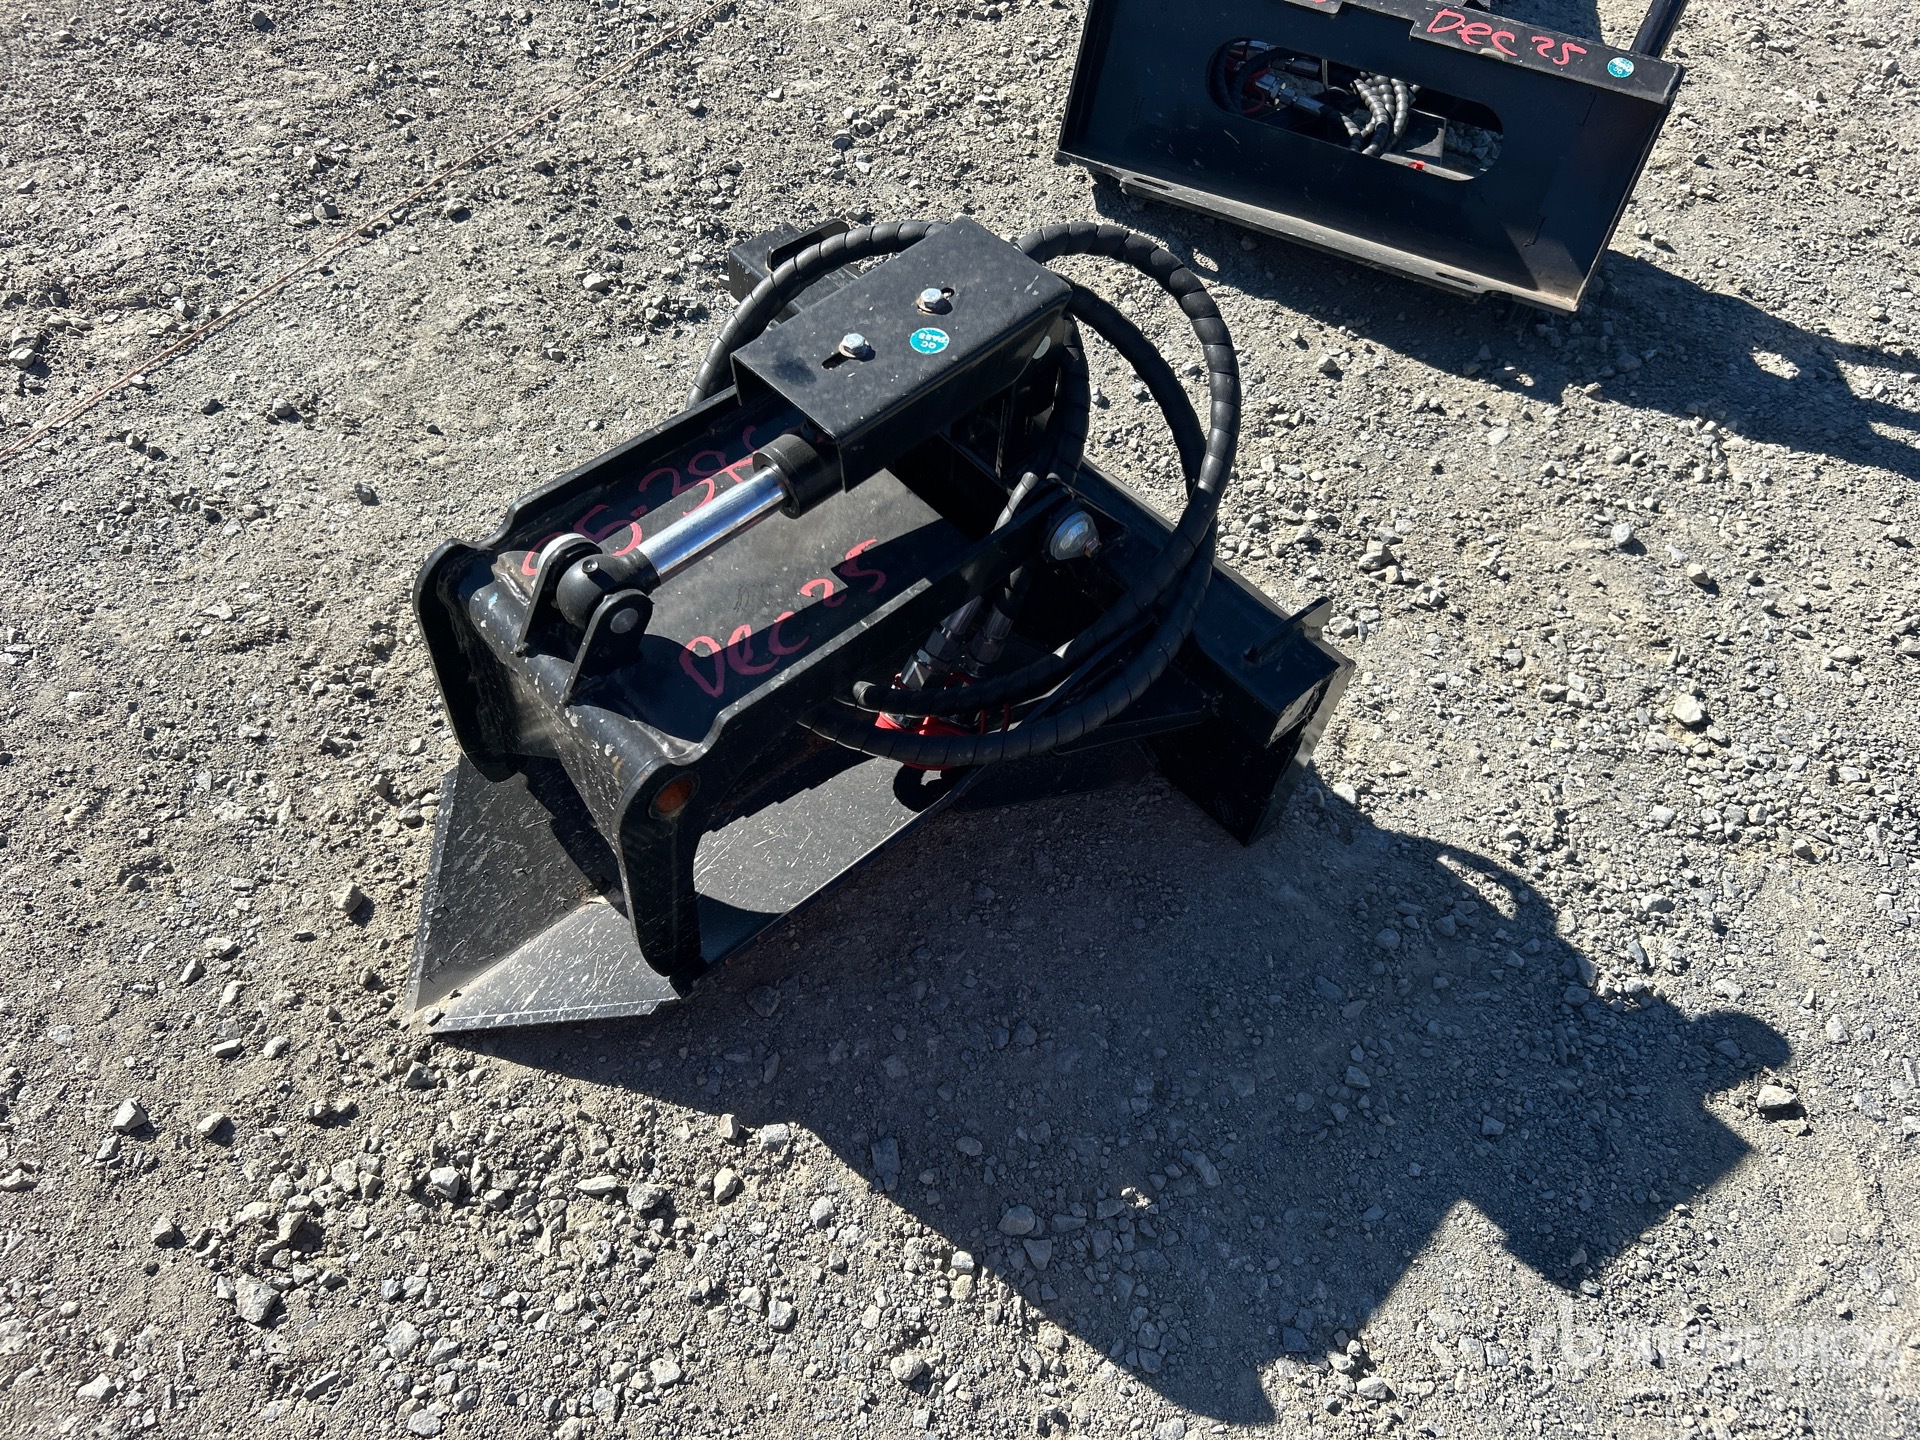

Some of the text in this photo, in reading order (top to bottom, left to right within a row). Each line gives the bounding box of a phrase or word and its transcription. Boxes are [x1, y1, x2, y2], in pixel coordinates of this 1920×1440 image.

[1530, 34, 1588, 66] 25
[920, 340, 937, 349] QC
[798, 538, 888, 608] 25
